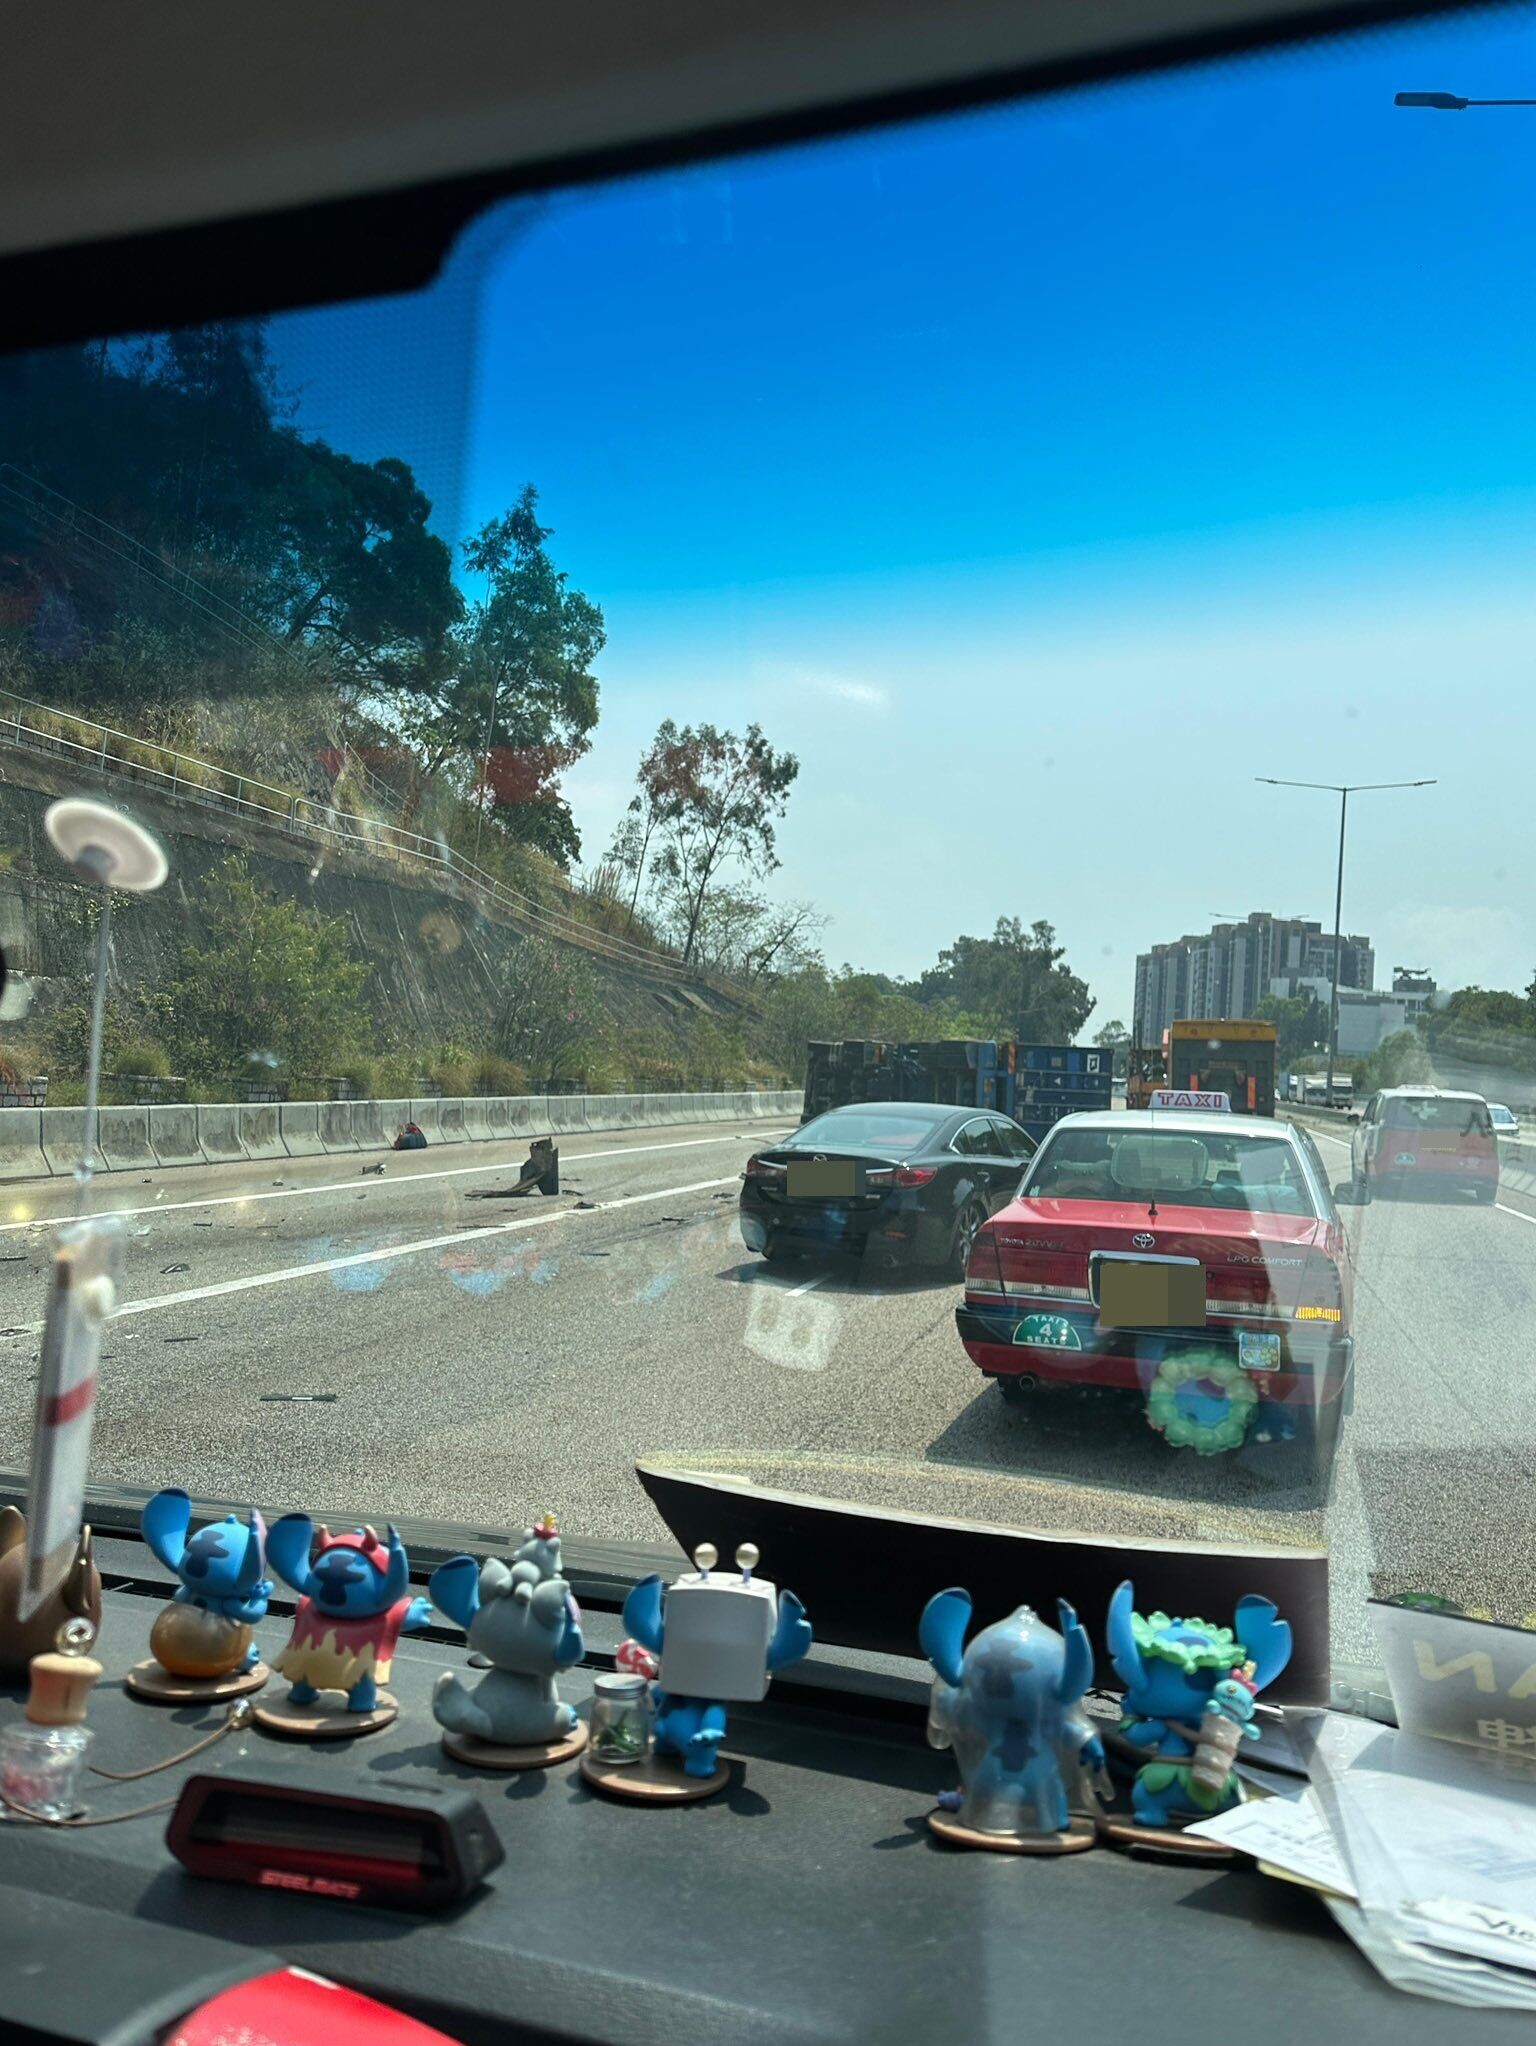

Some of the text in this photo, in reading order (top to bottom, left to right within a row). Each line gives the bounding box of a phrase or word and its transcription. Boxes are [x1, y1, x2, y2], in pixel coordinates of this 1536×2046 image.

[1157, 1092, 1223, 1108] TAXI
[1251, 1255, 1303, 1266] COMFORT
[1039, 1323, 1053, 1337] 4
